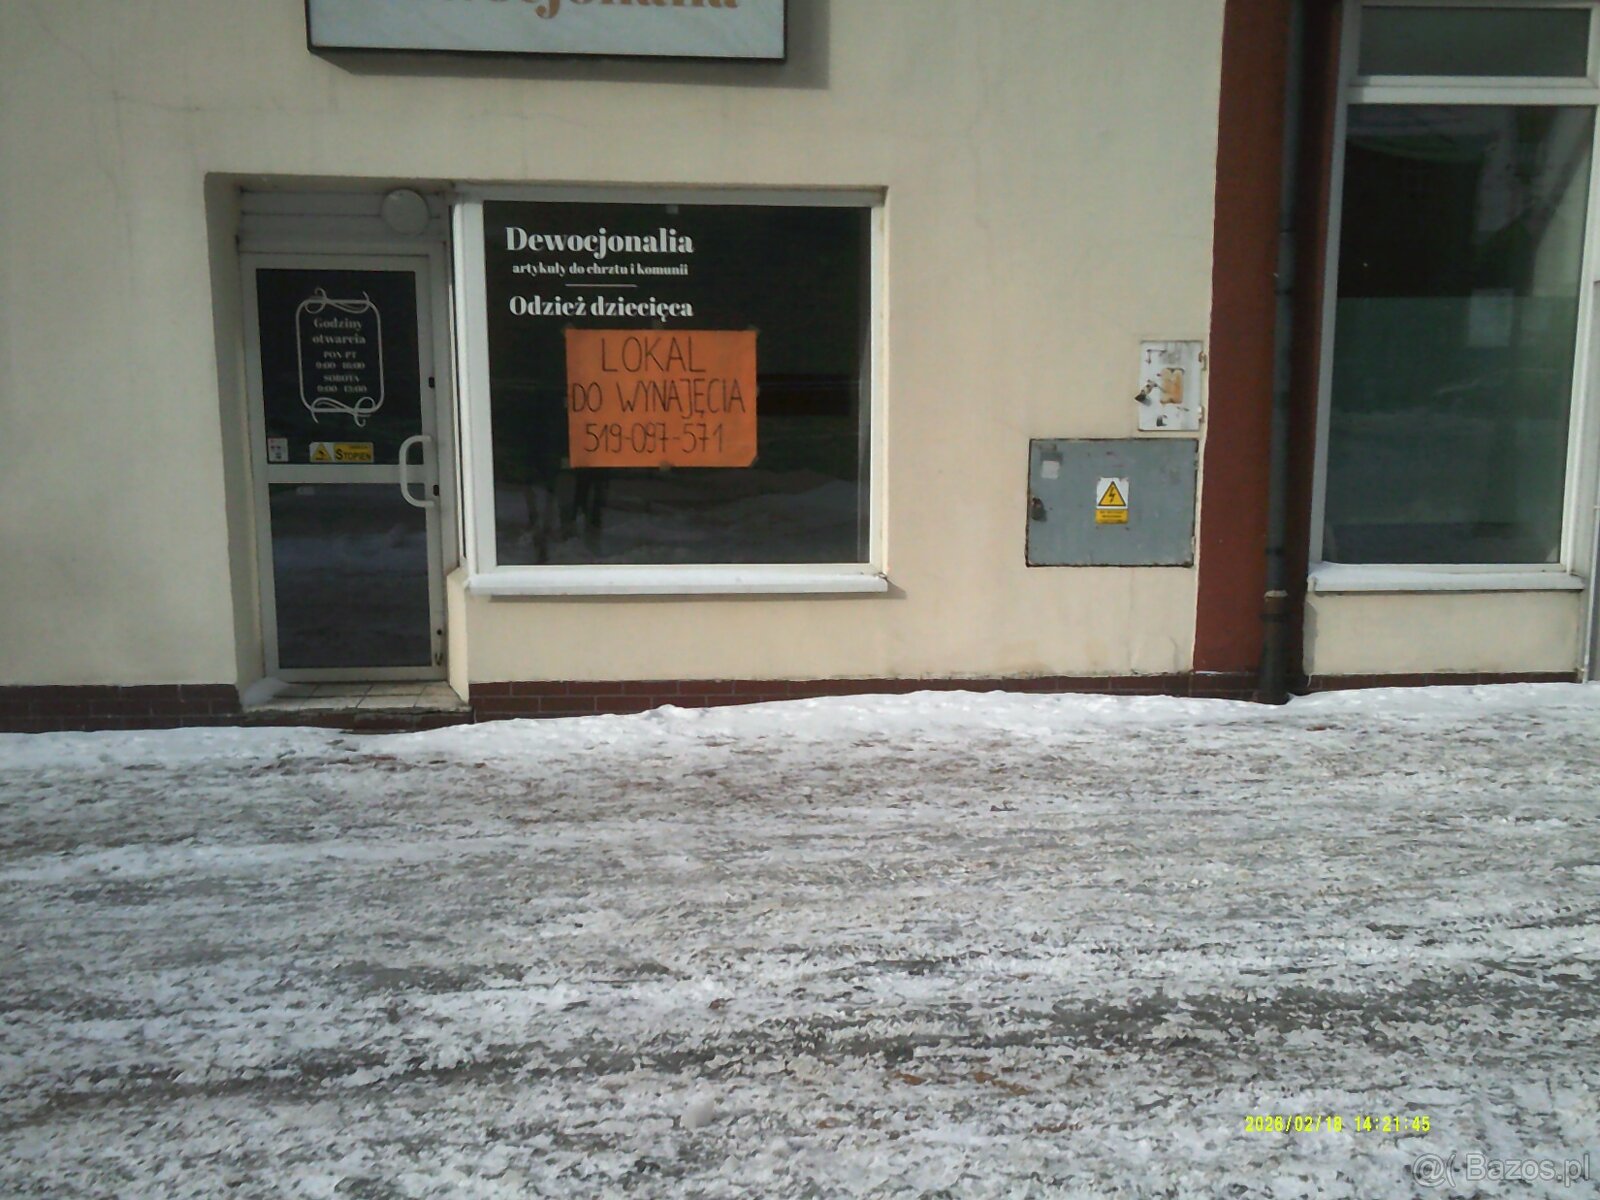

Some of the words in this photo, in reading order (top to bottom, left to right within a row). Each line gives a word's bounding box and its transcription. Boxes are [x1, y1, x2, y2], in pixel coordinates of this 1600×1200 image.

[505, 226, 694, 259] Dewocjonalia
[569, 263, 585, 275] do
[586, 263, 628, 275] chrztu
[630, 263, 635, 275] i
[637, 263, 689, 275] komunii
[509, 295, 587, 316] Odzież
[590, 296, 694, 322] dziecięca
[312, 333, 366, 344] otwarcia
[313, 317, 362, 331] Godziny
[601, 336, 706, 372] LOKAL
[572, 382, 603, 412] DO
[616, 378, 746, 419] WYNAJĘCIA
[584, 422, 724, 453] 519-097-571
